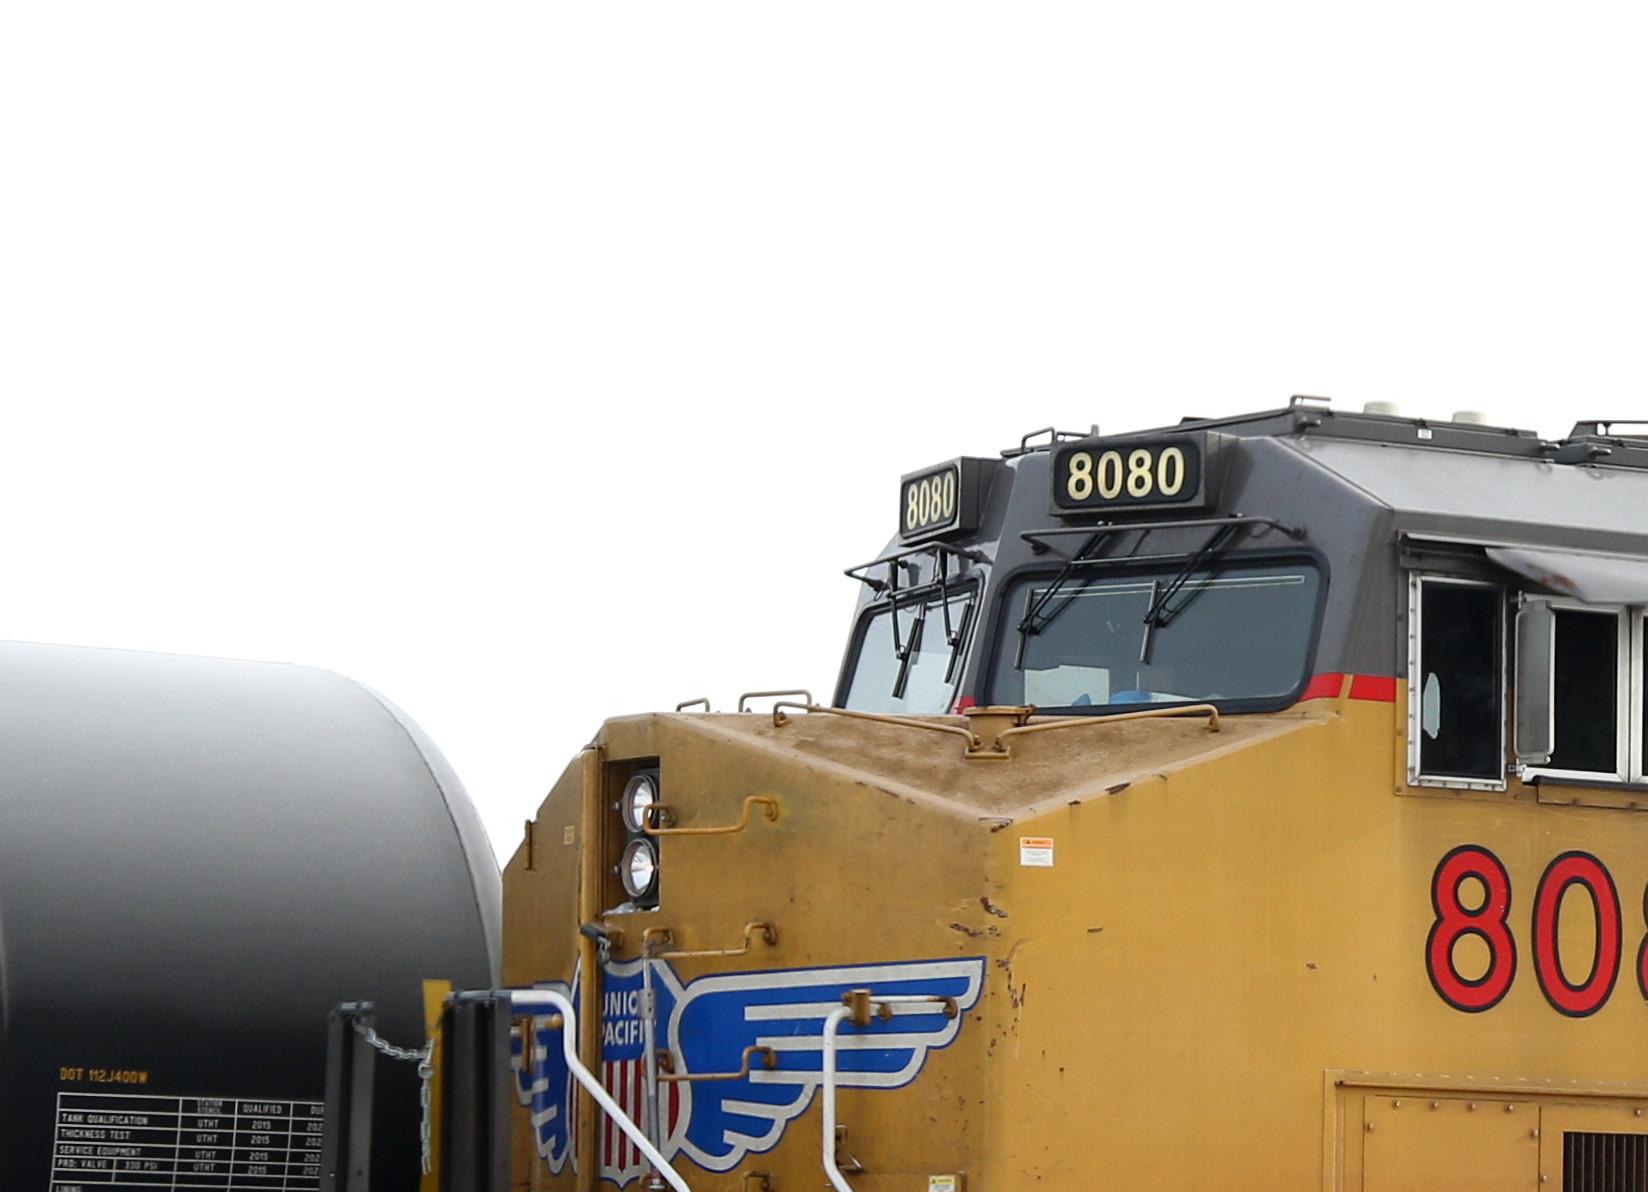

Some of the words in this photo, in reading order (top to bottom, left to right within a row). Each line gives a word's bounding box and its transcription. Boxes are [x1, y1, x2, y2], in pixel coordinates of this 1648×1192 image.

[1066, 446, 1186, 501] 8080
[905, 470, 955, 530] 8080
[601, 1019, 645, 1047] ACIFI
[60, 1066, 83, 1081] DOT
[89, 1068, 148, 1084] 112J400W
[242, 1103, 282, 1114] QUALIFIED
[62, 1113, 84, 1123] TANK
[87, 1114, 148, 1125] QUALIFICATION
[251, 1120, 271, 1130] 2015
[60, 1128, 106, 1139] THICKNESS
[110, 1130, 131, 1140] TEST
[250, 1135, 270, 1145] 2015
[59, 1145, 93, 1155] SERVICE
[249, 1151, 269, 1161] 2015
[80, 1159, 107, 1169] VALVE
